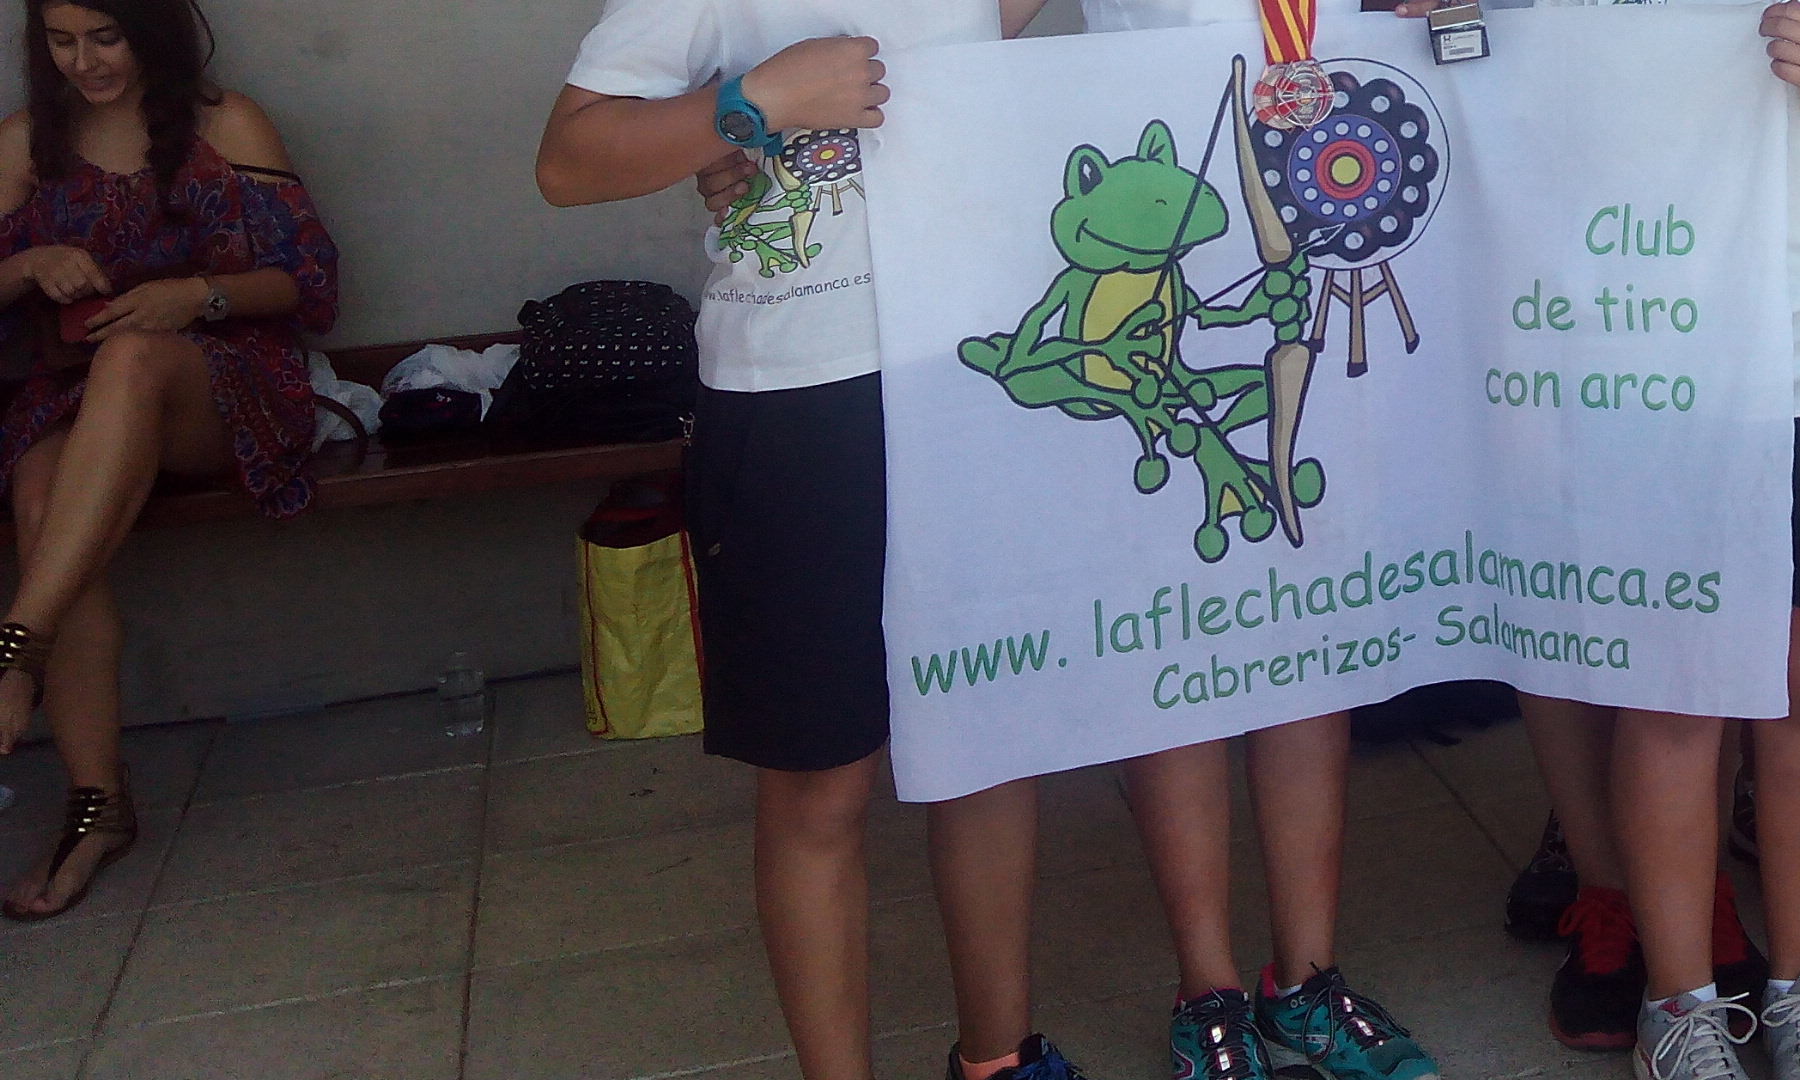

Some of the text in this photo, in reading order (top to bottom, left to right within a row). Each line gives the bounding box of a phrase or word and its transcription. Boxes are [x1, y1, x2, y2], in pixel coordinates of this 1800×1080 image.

[1585, 204, 1696, 258] Club
[1511, 278, 1699, 334] de tiro
[1484, 366, 1697, 412] con arco
[911, 529, 1722, 697] www. laflechadesalamanca.es
[1435, 603, 1630, 671] Salamanca
